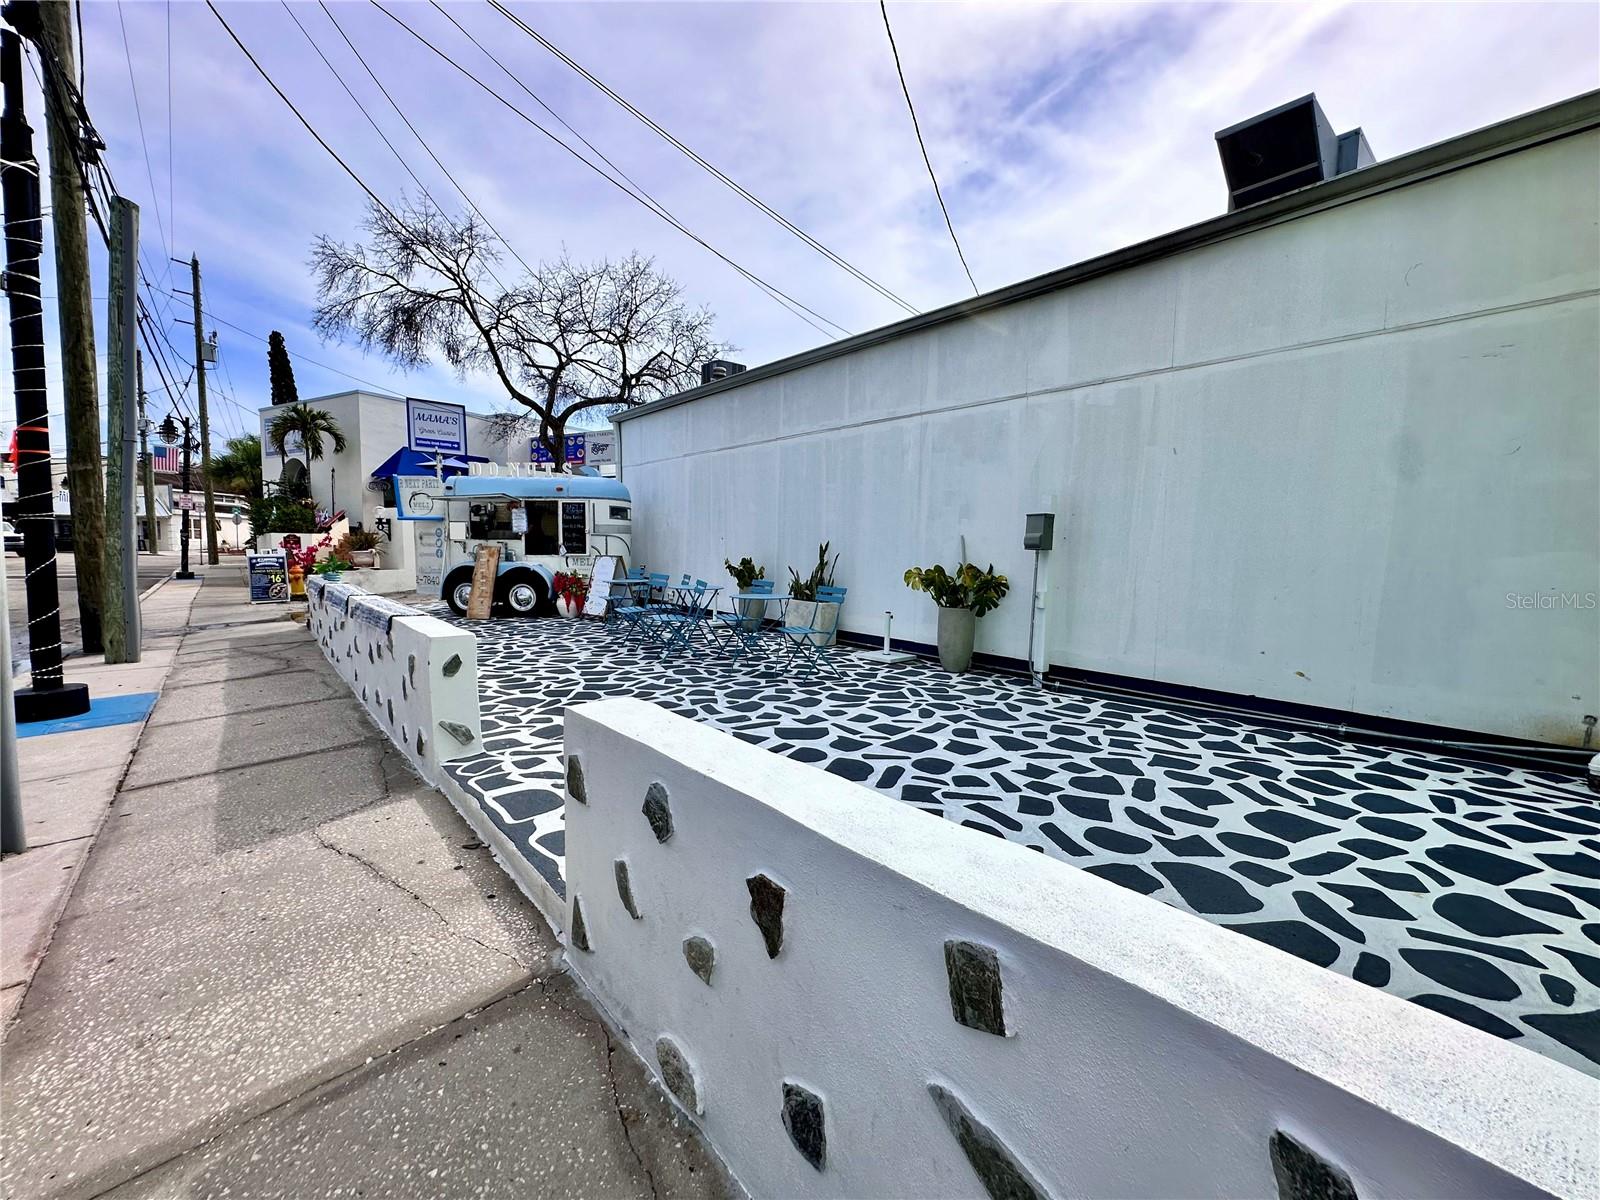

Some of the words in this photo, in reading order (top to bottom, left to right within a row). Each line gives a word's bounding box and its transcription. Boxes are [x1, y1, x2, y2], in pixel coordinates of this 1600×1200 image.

[416, 412, 458, 425] MAMA'S
[468, 461, 573, 478] DONUTS
[404, 479, 420, 488] NEXT
[421, 479, 440, 488] PARTY
[571, 557, 594, 567] MEL
